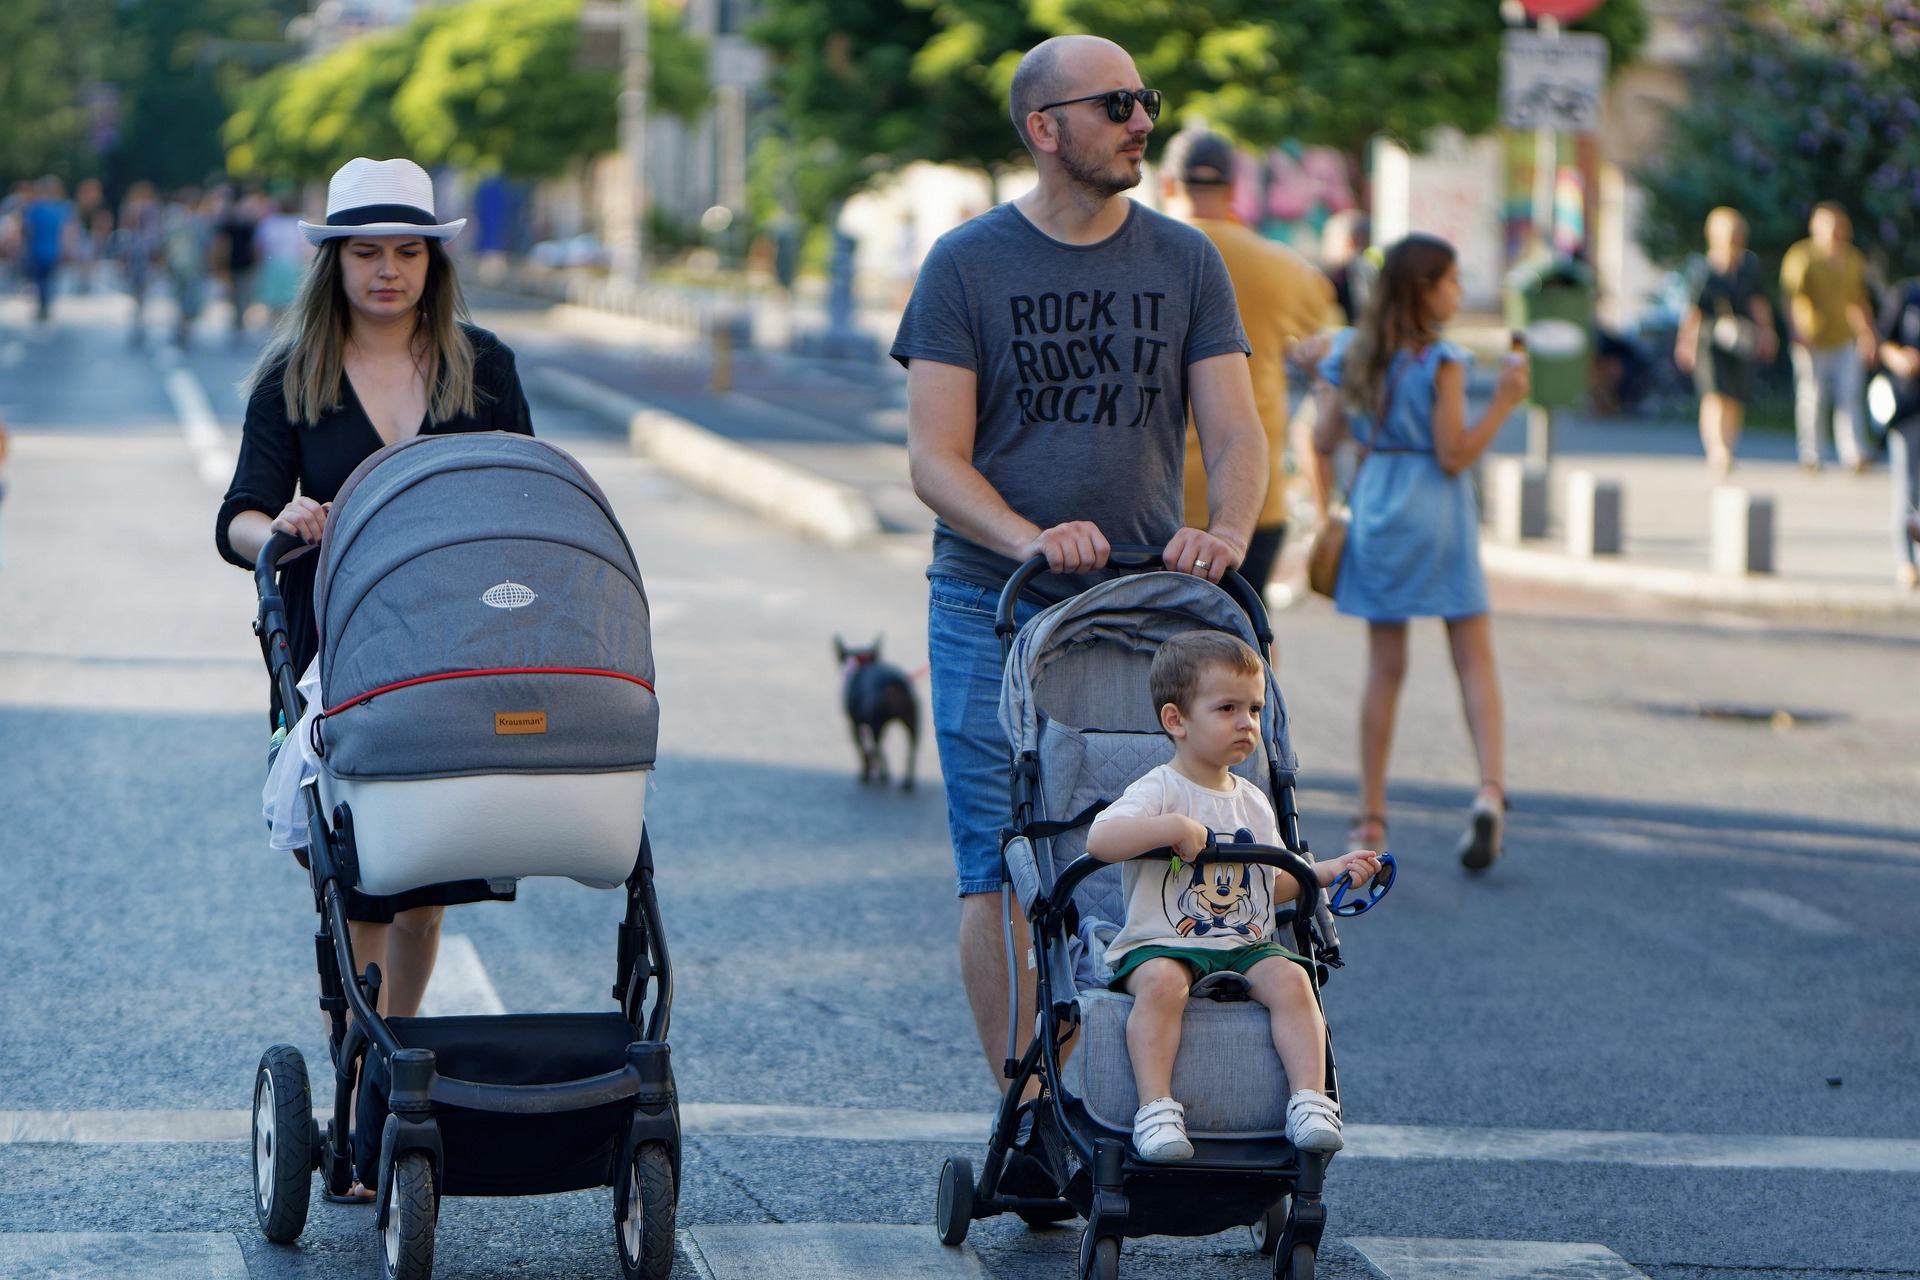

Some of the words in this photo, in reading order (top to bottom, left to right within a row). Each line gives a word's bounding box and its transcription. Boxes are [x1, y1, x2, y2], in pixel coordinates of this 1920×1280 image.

[1010, 290, 1117, 335] ROCK
[1132, 292, 1165, 331] IT
[1012, 334, 1120, 383] ROCK
[1133, 336, 1168, 375] IT
[1016, 383, 1123, 426] ROCK
[1128, 386, 1161, 427] IT
